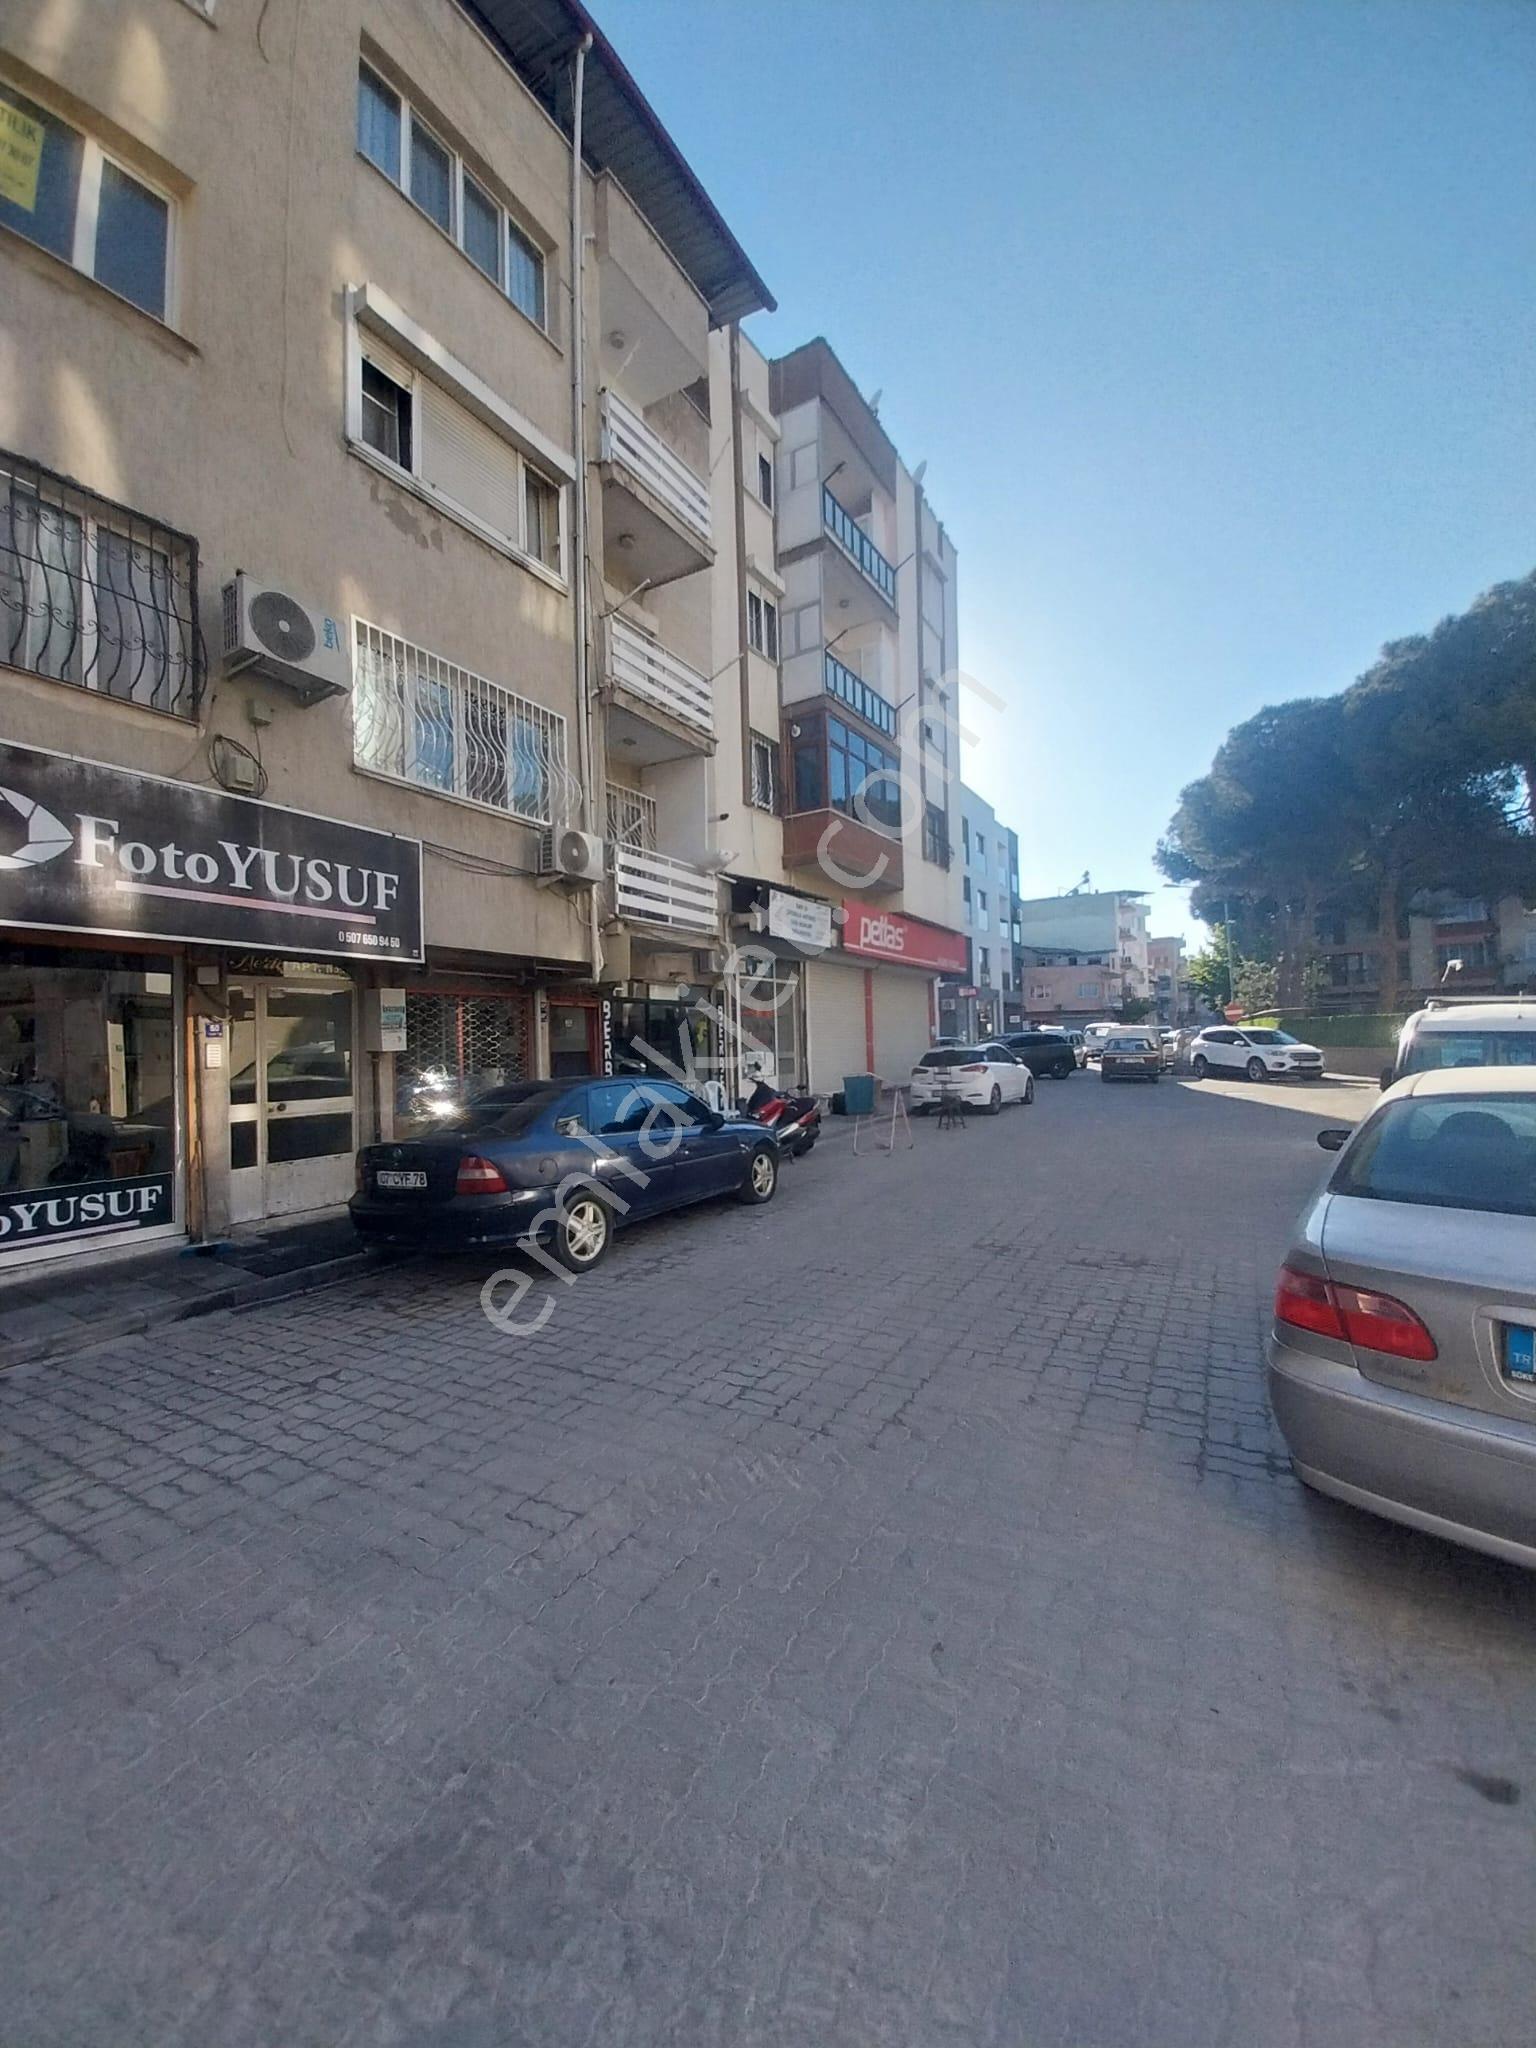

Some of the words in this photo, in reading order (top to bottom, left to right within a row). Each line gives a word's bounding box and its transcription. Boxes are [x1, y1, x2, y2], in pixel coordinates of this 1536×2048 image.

[323, 617, 334, 649] beko
[338, 930, 345, 942] 0
[860, 916, 904, 950] petlas
[602, 1000, 613, 1077] BERB
